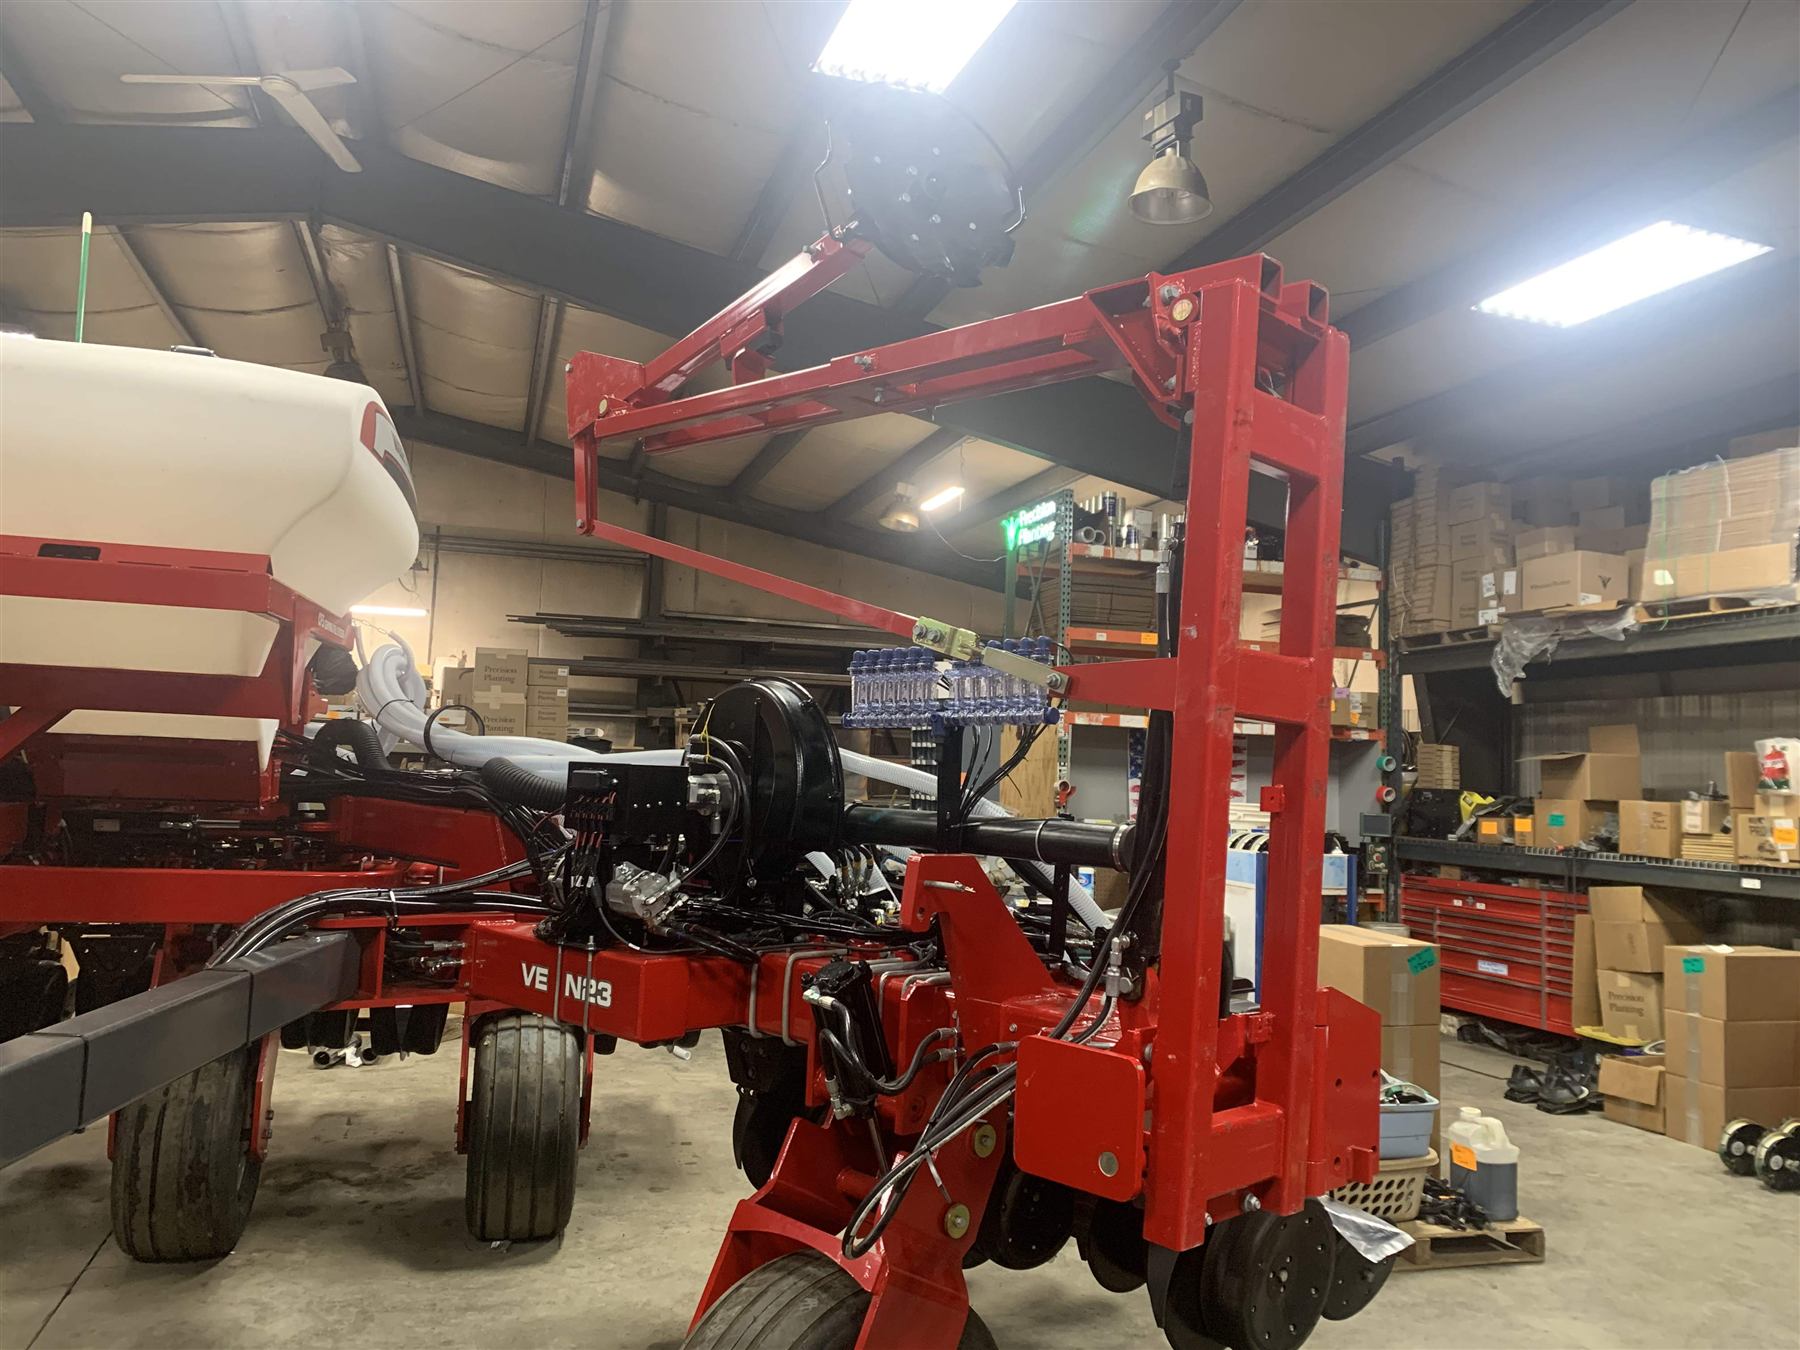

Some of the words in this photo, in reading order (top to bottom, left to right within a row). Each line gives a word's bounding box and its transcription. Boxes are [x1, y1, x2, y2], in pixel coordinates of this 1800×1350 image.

[484, 665, 518, 674] Precision
[484, 674, 516, 685] Planting
[483, 715, 516, 723] Precision
[1608, 991, 1645, 1003] Precision
[1609, 1003, 1645, 1017] Planting
